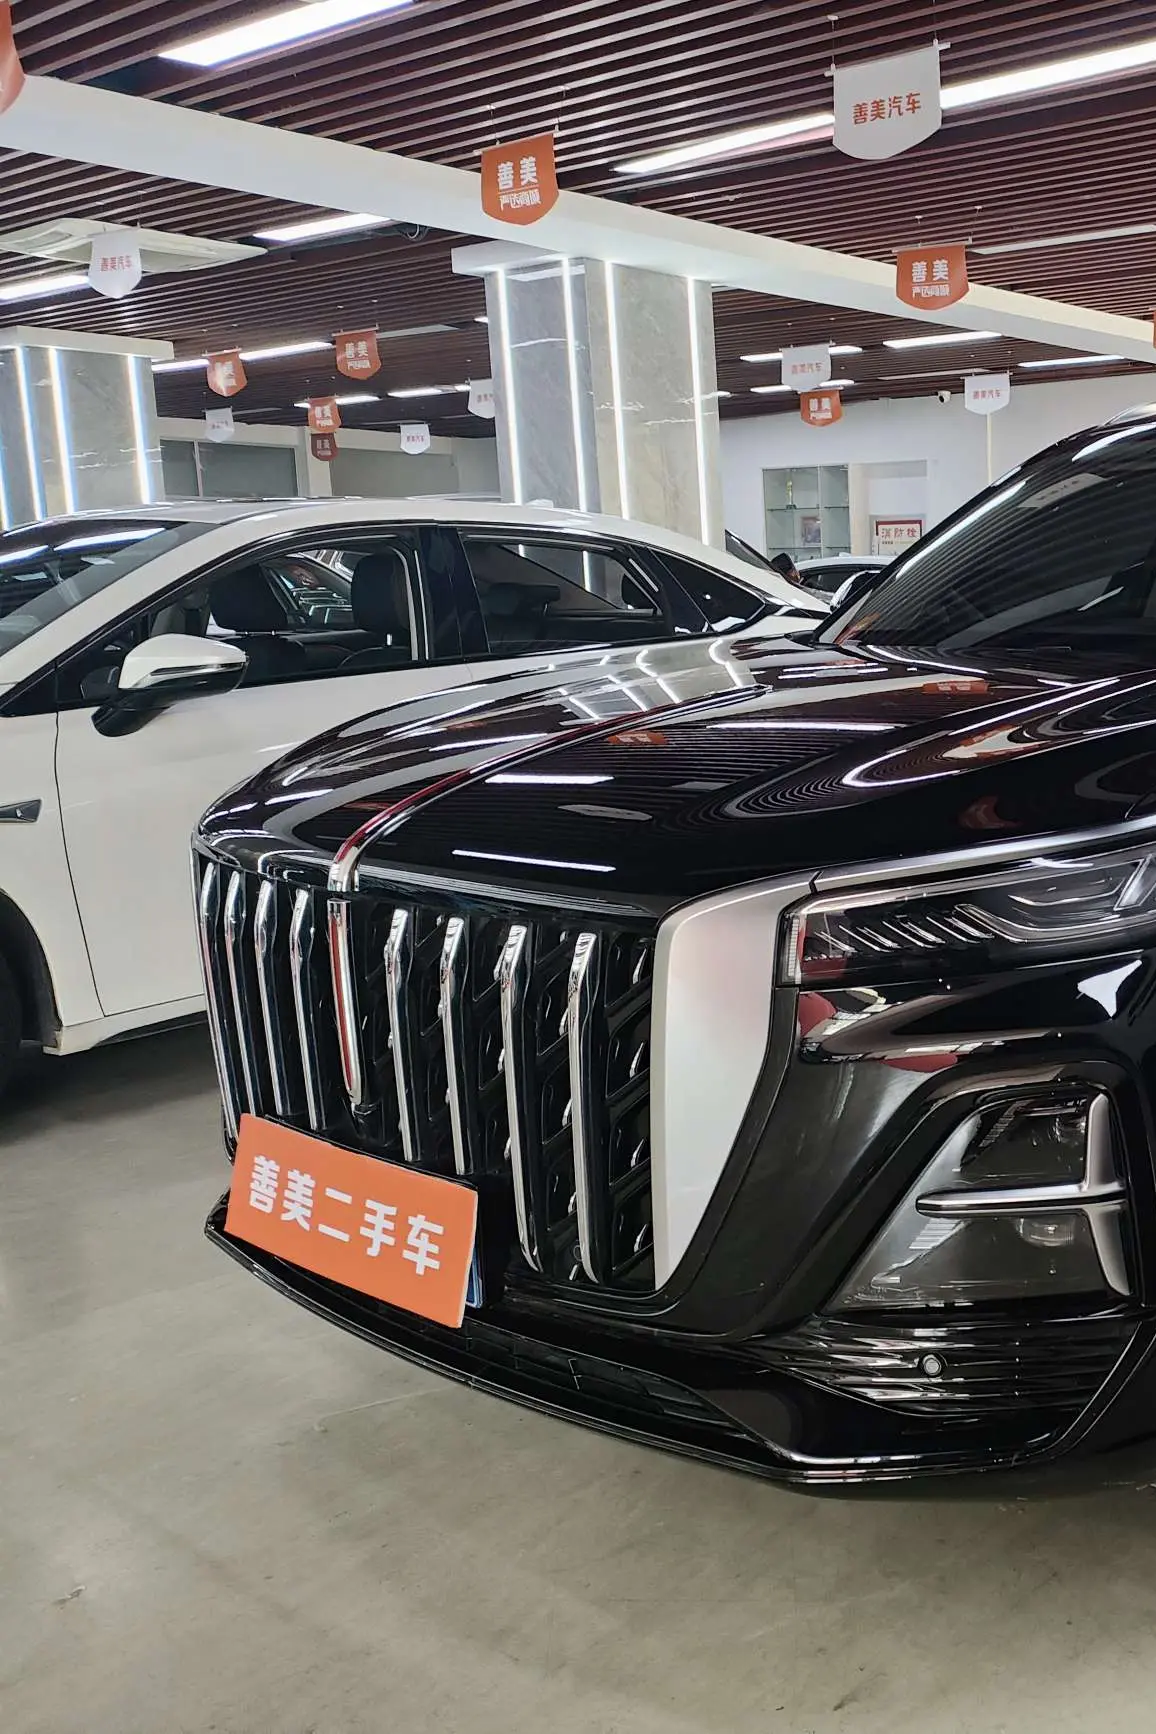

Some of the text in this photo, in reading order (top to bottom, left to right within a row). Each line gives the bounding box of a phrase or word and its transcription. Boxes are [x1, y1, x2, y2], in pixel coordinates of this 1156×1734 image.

[853, 92, 921, 125] 善美汽车
[497, 156, 538, 190] 善美
[911, 259, 949, 283] 善美
[249, 1155, 444, 1276] 善美二手车
